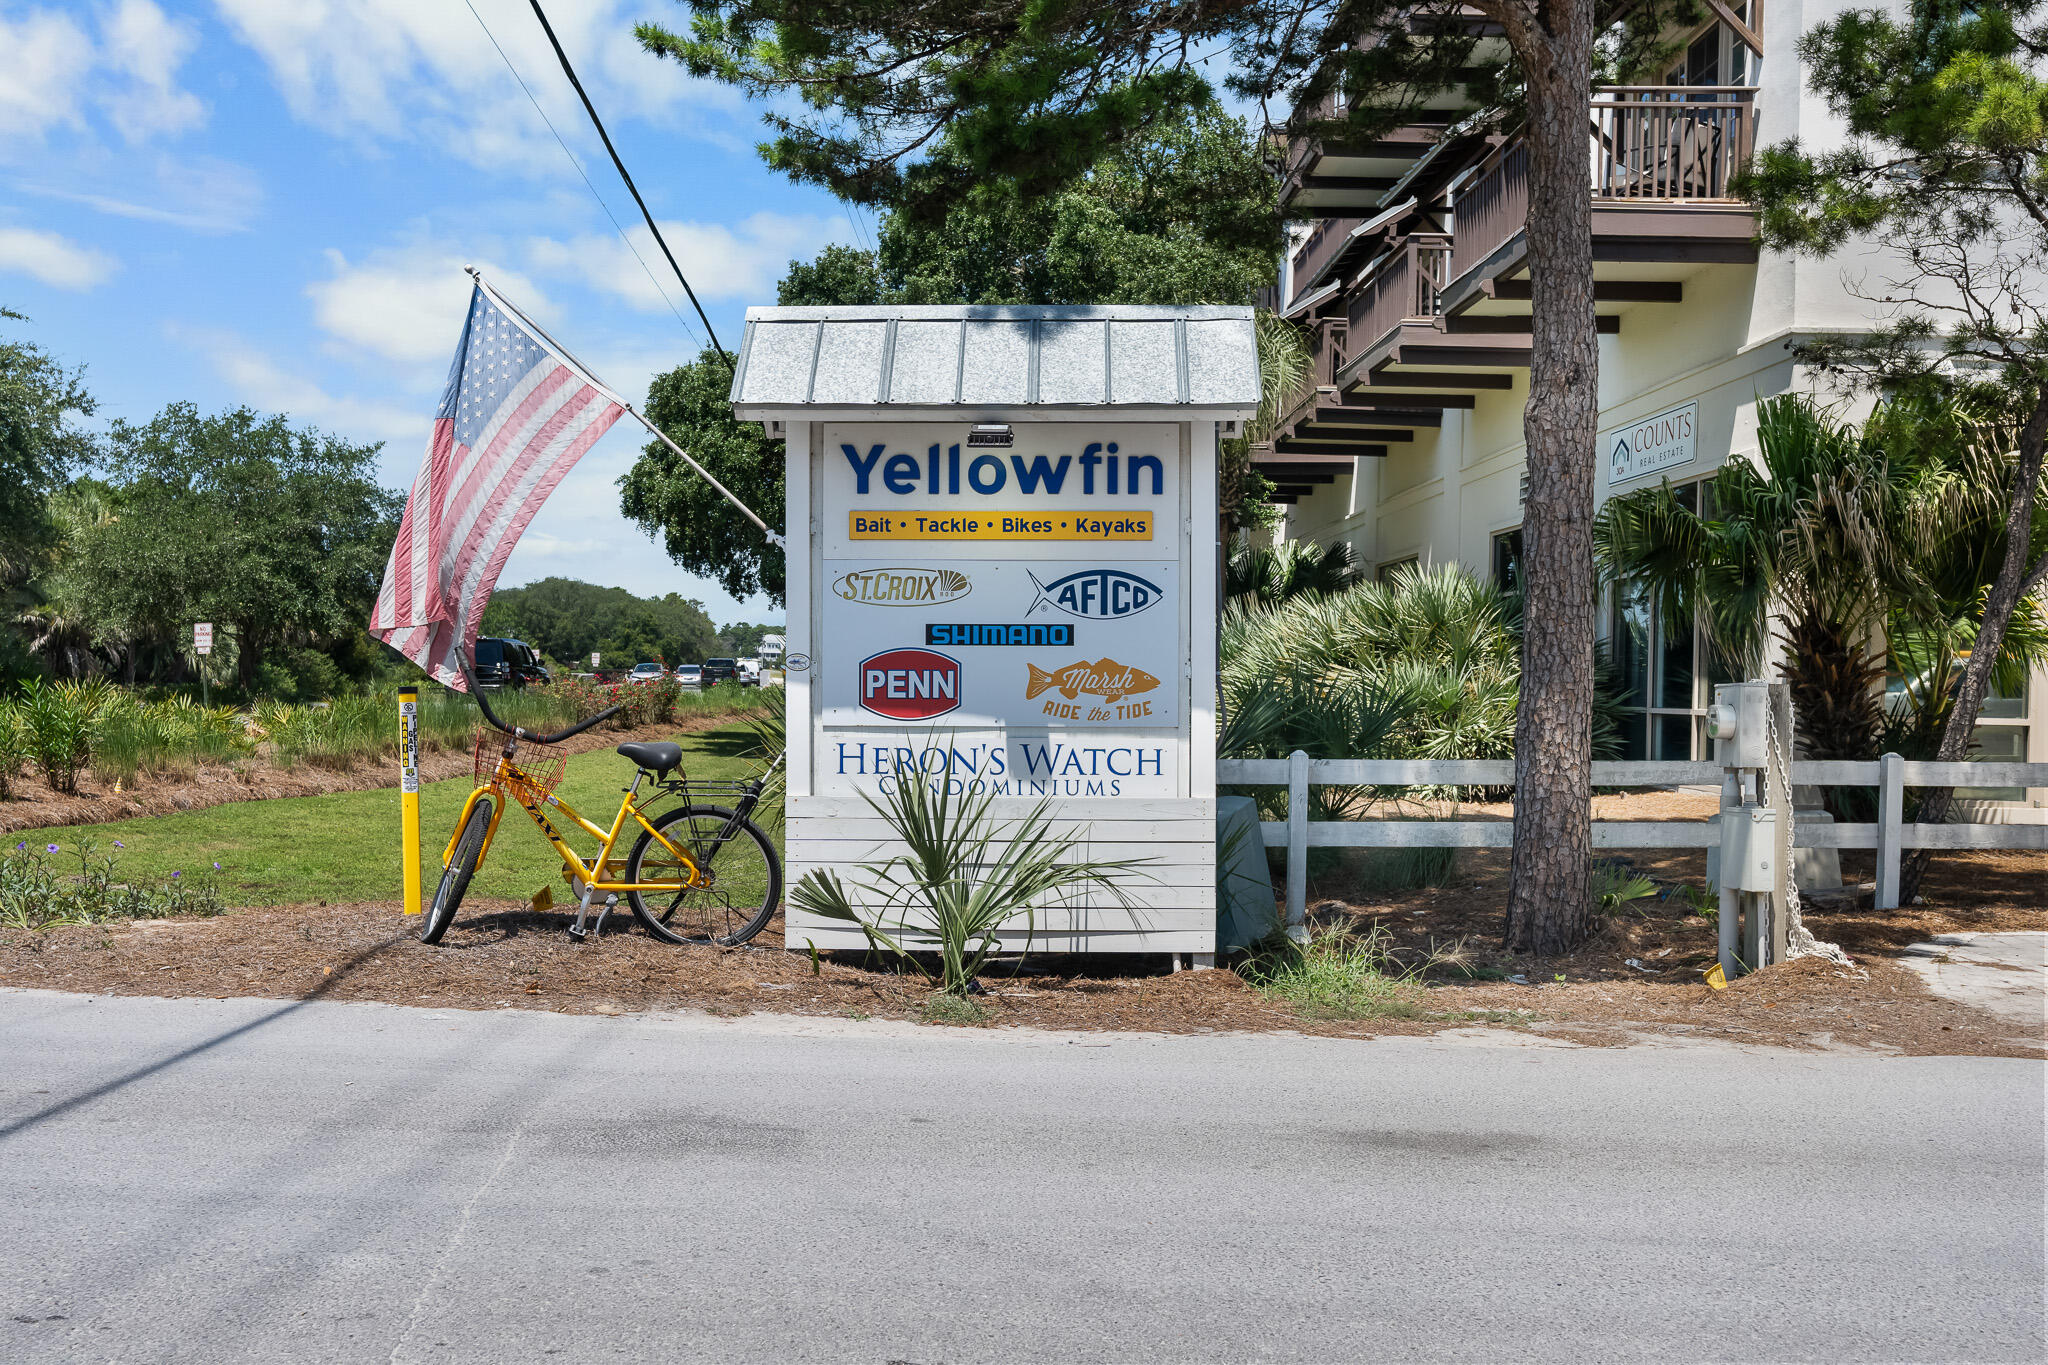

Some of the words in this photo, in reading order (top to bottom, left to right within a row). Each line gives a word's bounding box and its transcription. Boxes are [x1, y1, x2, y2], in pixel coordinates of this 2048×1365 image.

[1634, 411, 1691, 452] COUNTS
[840, 442, 1164, 495] Yellowfin
[1640, 456, 1655, 468] REAL
[1659, 445, 1684, 462] ESTATE
[855, 517, 892, 533] Bait
[916, 517, 979, 533] Tackle
[1002, 517, 1053, 533] Bikes
[1076, 517, 1147, 537] Kayaks
[1057, 574, 1149, 616] AFTCO
[931, 625, 1068, 645] SHIMANO
[866, 670, 955, 699] PENN
[1062, 666, 1135, 691] Marsh
[1042, 700, 1081, 720] RIDE
[1087, 706, 1112, 721] the
[1116, 700, 1153, 721] TIDE
[401, 715, 409, 767] WARNING
[836, 742, 1006, 776] HERON'S
[1019, 743, 1165, 777] WATCH
[526, 802, 561, 842] TAXI
